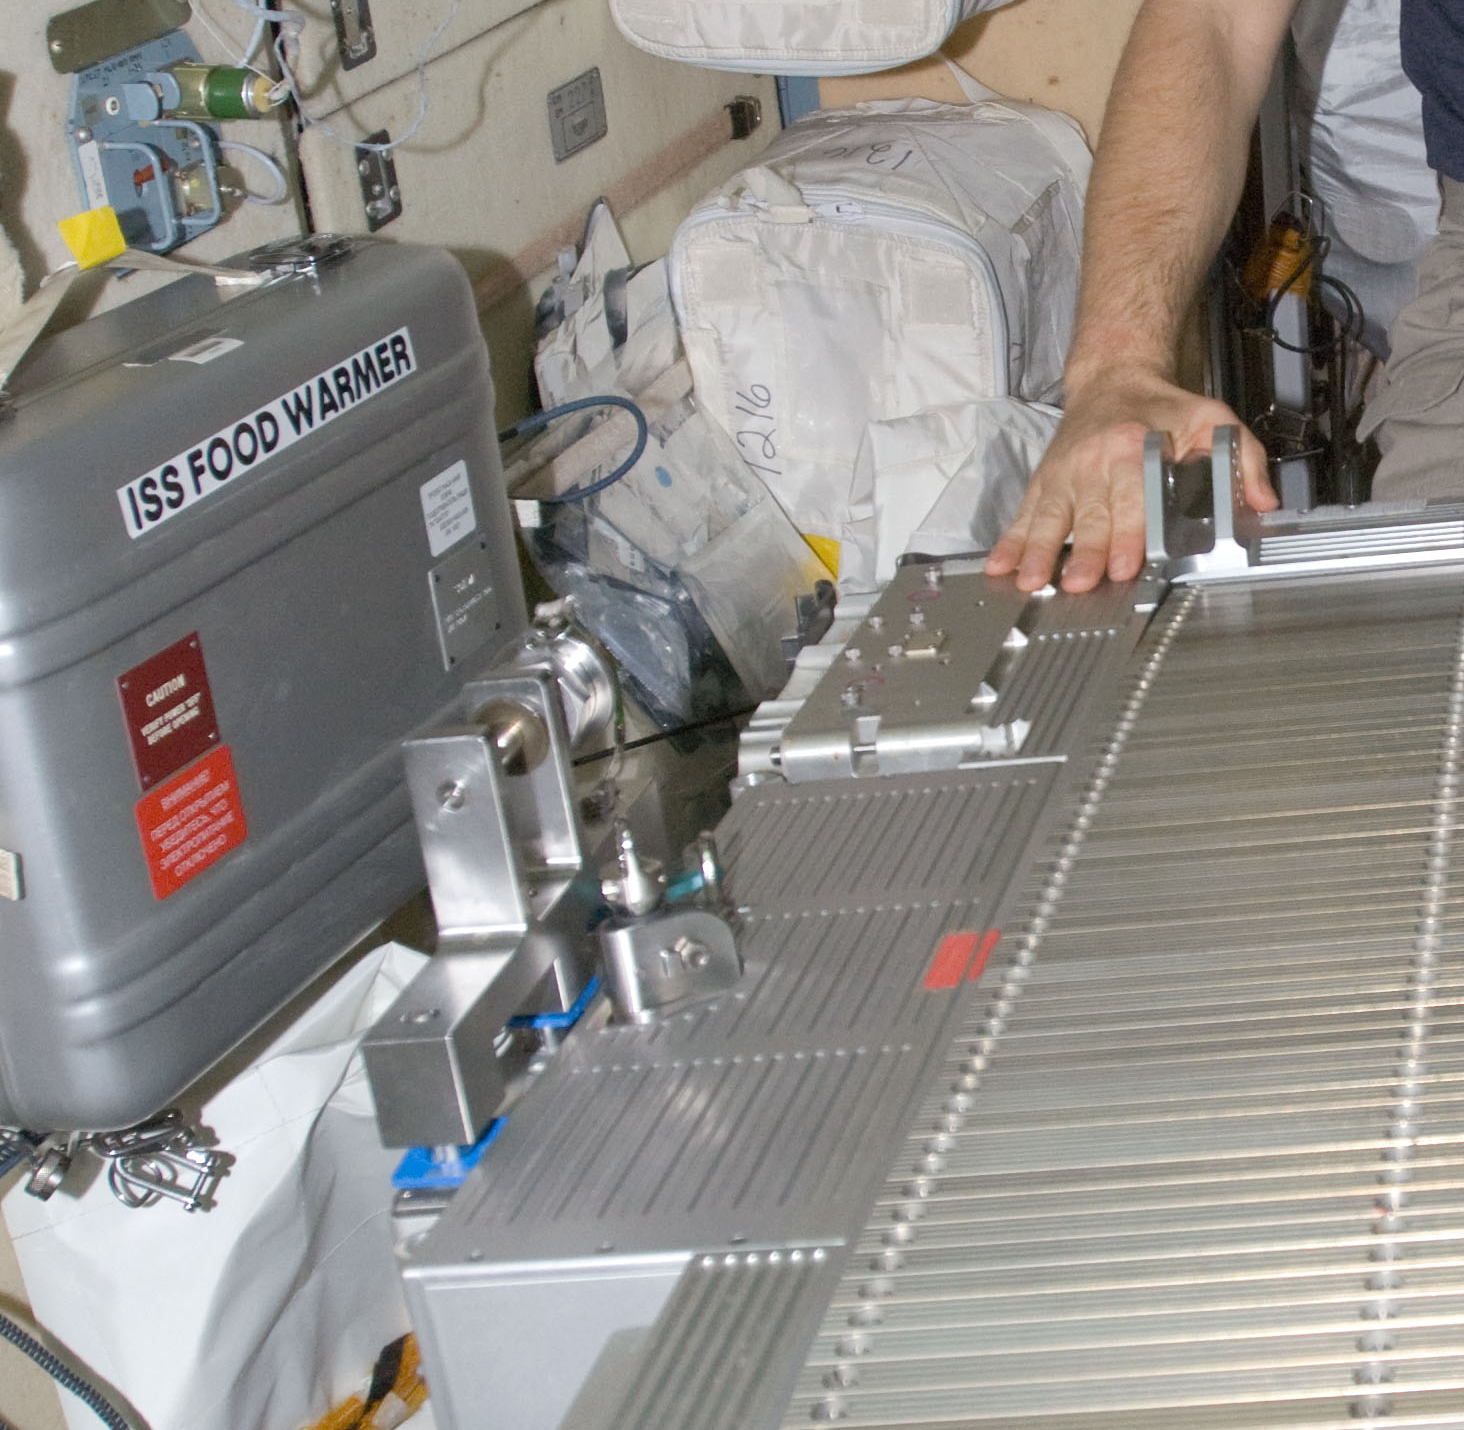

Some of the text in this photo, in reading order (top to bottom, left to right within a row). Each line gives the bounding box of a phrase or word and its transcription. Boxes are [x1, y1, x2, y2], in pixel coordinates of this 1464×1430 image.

[127, 334, 412, 530] ISS FOOD WARMER
[736, 383, 782, 476] 1216
[146, 673, 187, 708] CAUTION
